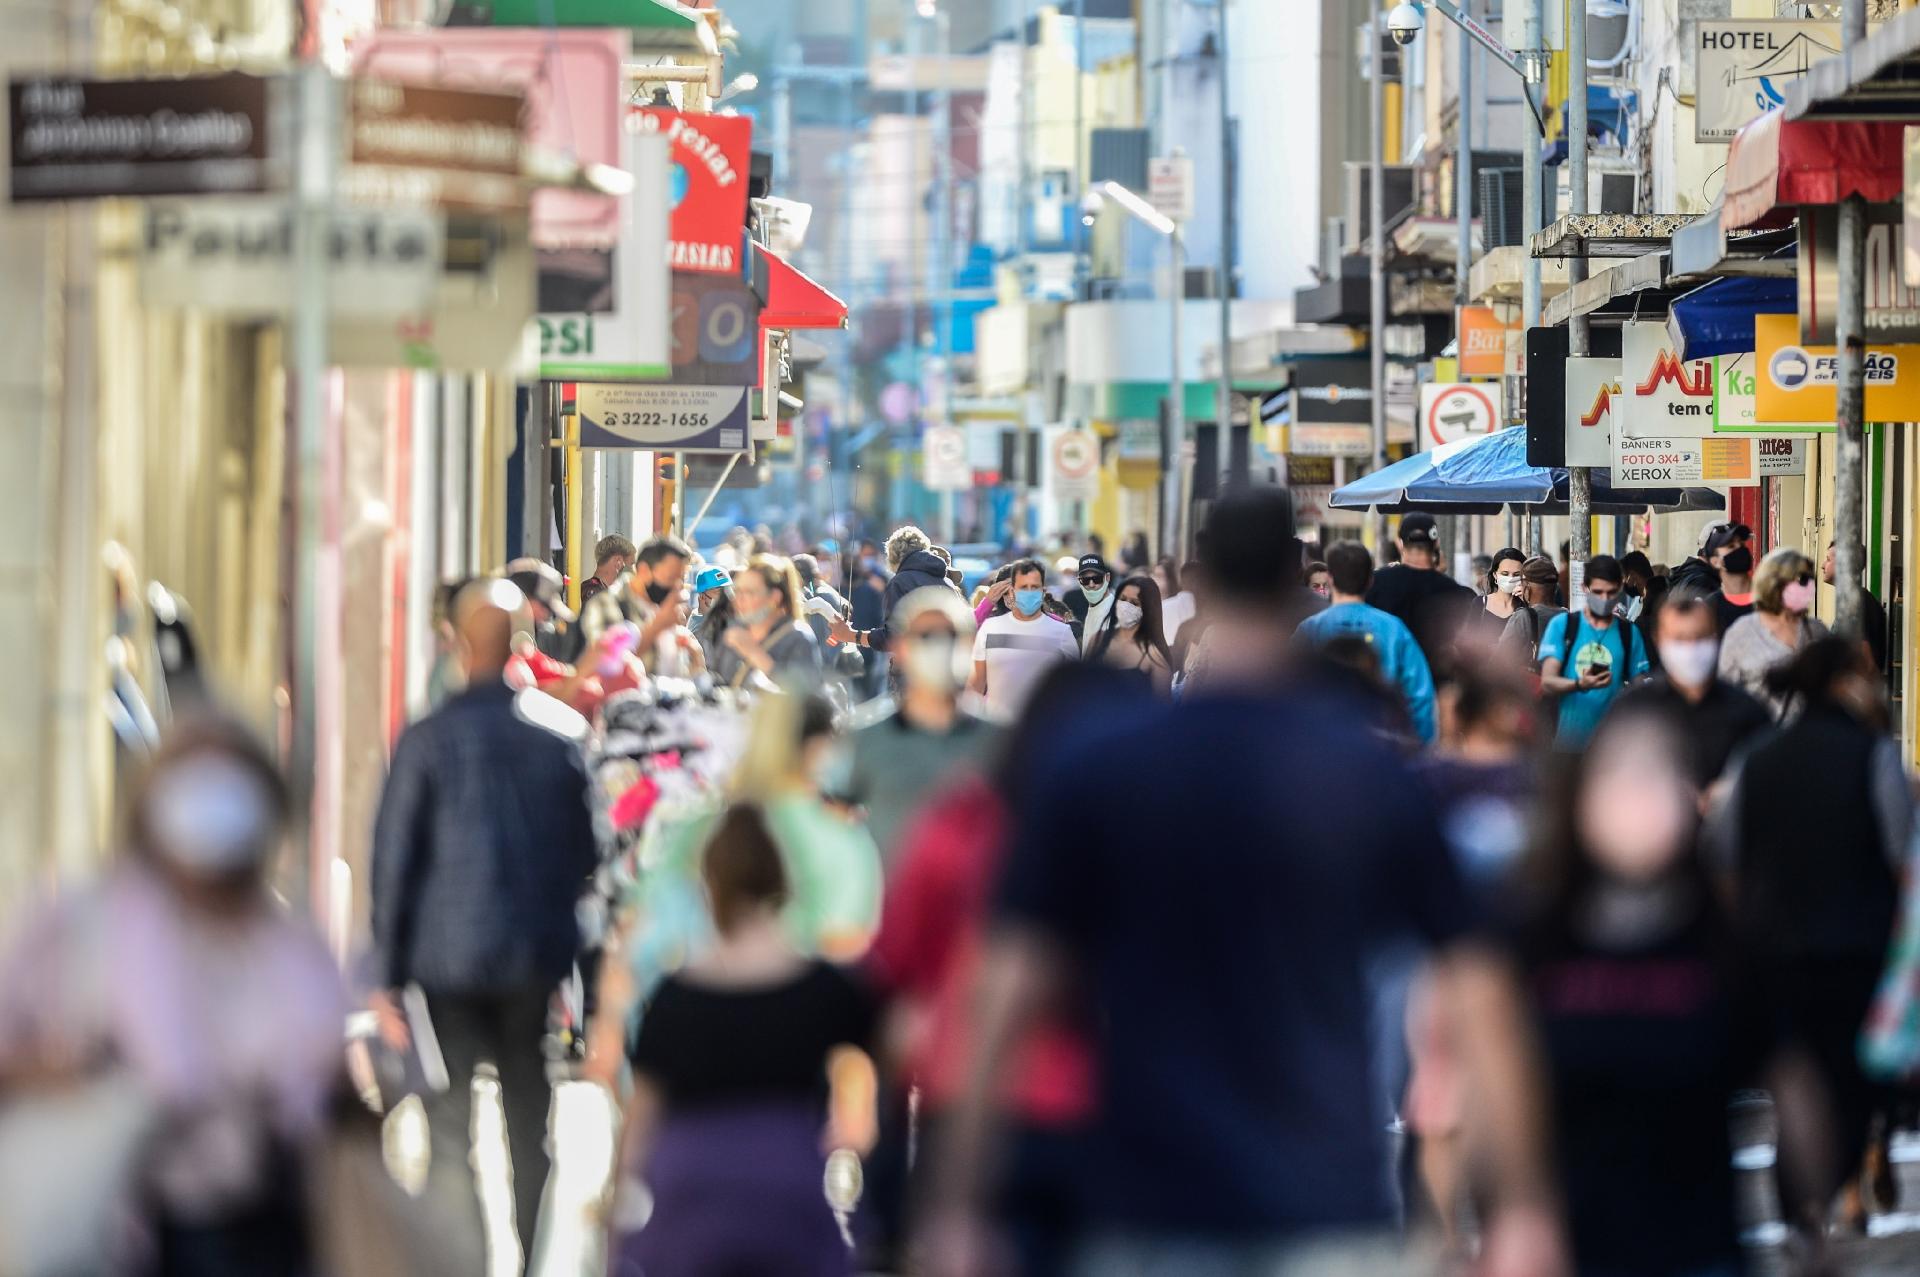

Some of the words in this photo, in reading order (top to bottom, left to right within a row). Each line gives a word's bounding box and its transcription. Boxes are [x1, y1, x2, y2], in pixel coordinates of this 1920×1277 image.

[1702, 32, 1779, 49] HOTEL
[1668, 402, 1700, 415] tem
[622, 413, 709, 426] 3222-1656
[1759, 438, 1793, 455] ntes
[1621, 454, 1655, 465] FOTO
[1658, 453, 1680, 464] 3X4
[1621, 468, 1672, 480] XEROX
